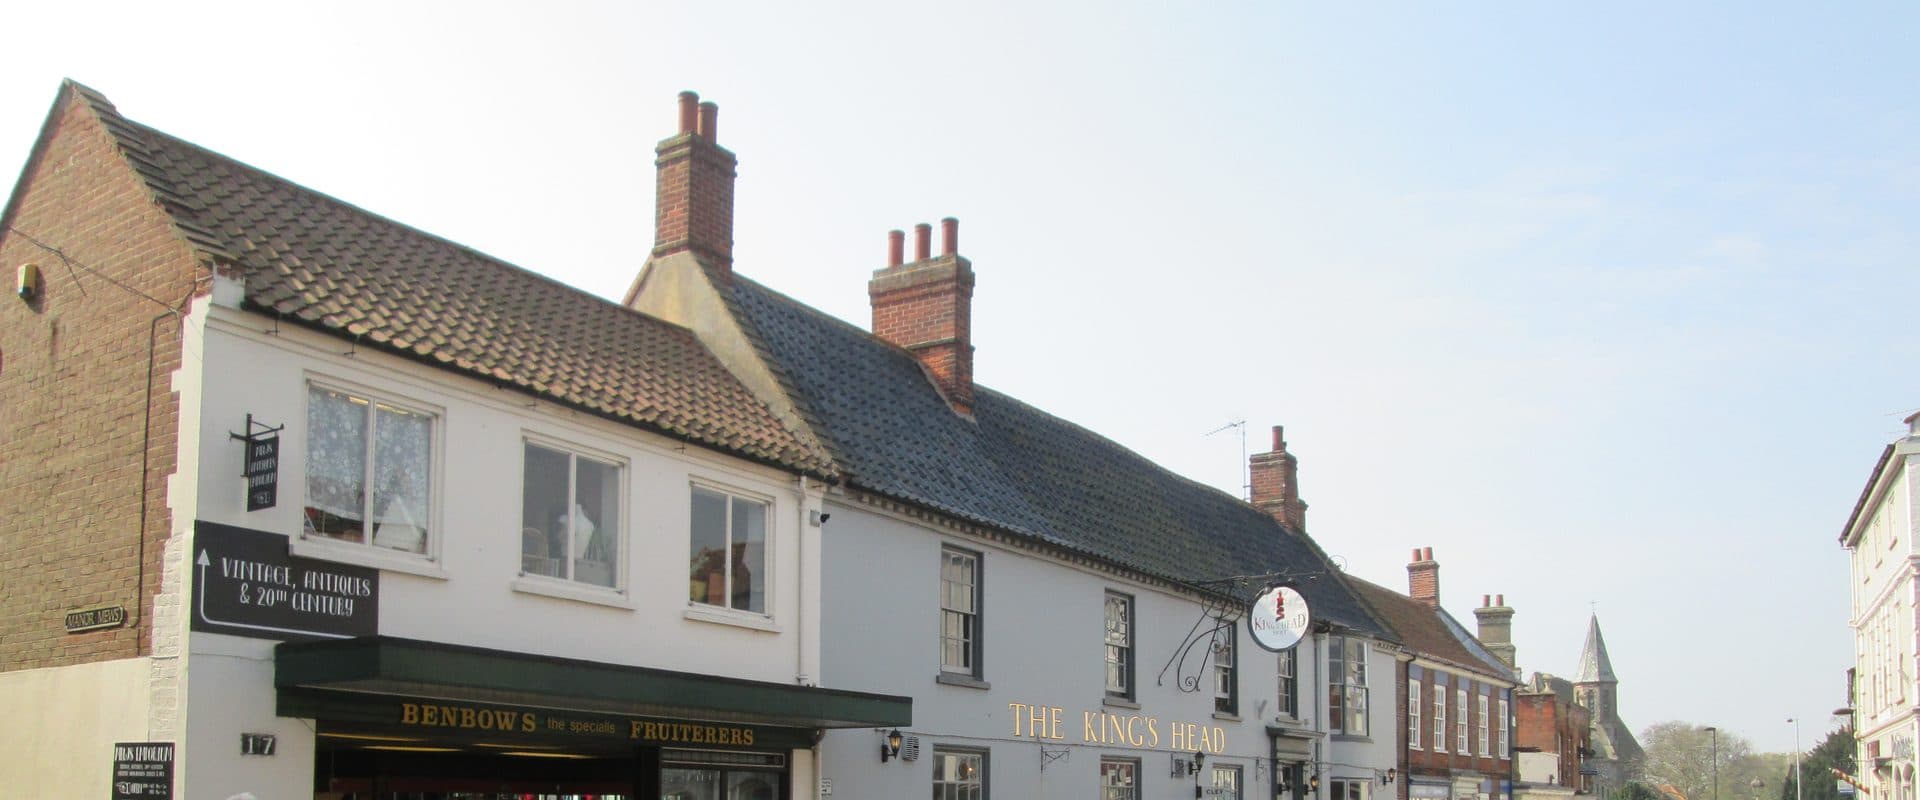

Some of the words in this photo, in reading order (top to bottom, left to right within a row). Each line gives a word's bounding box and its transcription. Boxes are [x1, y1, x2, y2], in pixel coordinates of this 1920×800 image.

[222, 556, 297, 590] VINTAGE,
[304, 570, 371, 597] ANTIQUES
[239, 582, 251, 604] &
[292, 591, 353, 616] CENTURY
[67, 612, 95, 629] MANOR
[97, 608, 120, 625] MEWS
[547, 717, 565, 731] the
[630, 720, 754, 746] FRUITERERS
[1008, 703, 1065, 740] THE
[1083, 710, 1158, 748] KING'S
[1171, 722, 1225, 754] HEAD
[247, 736, 273, 755] 17
